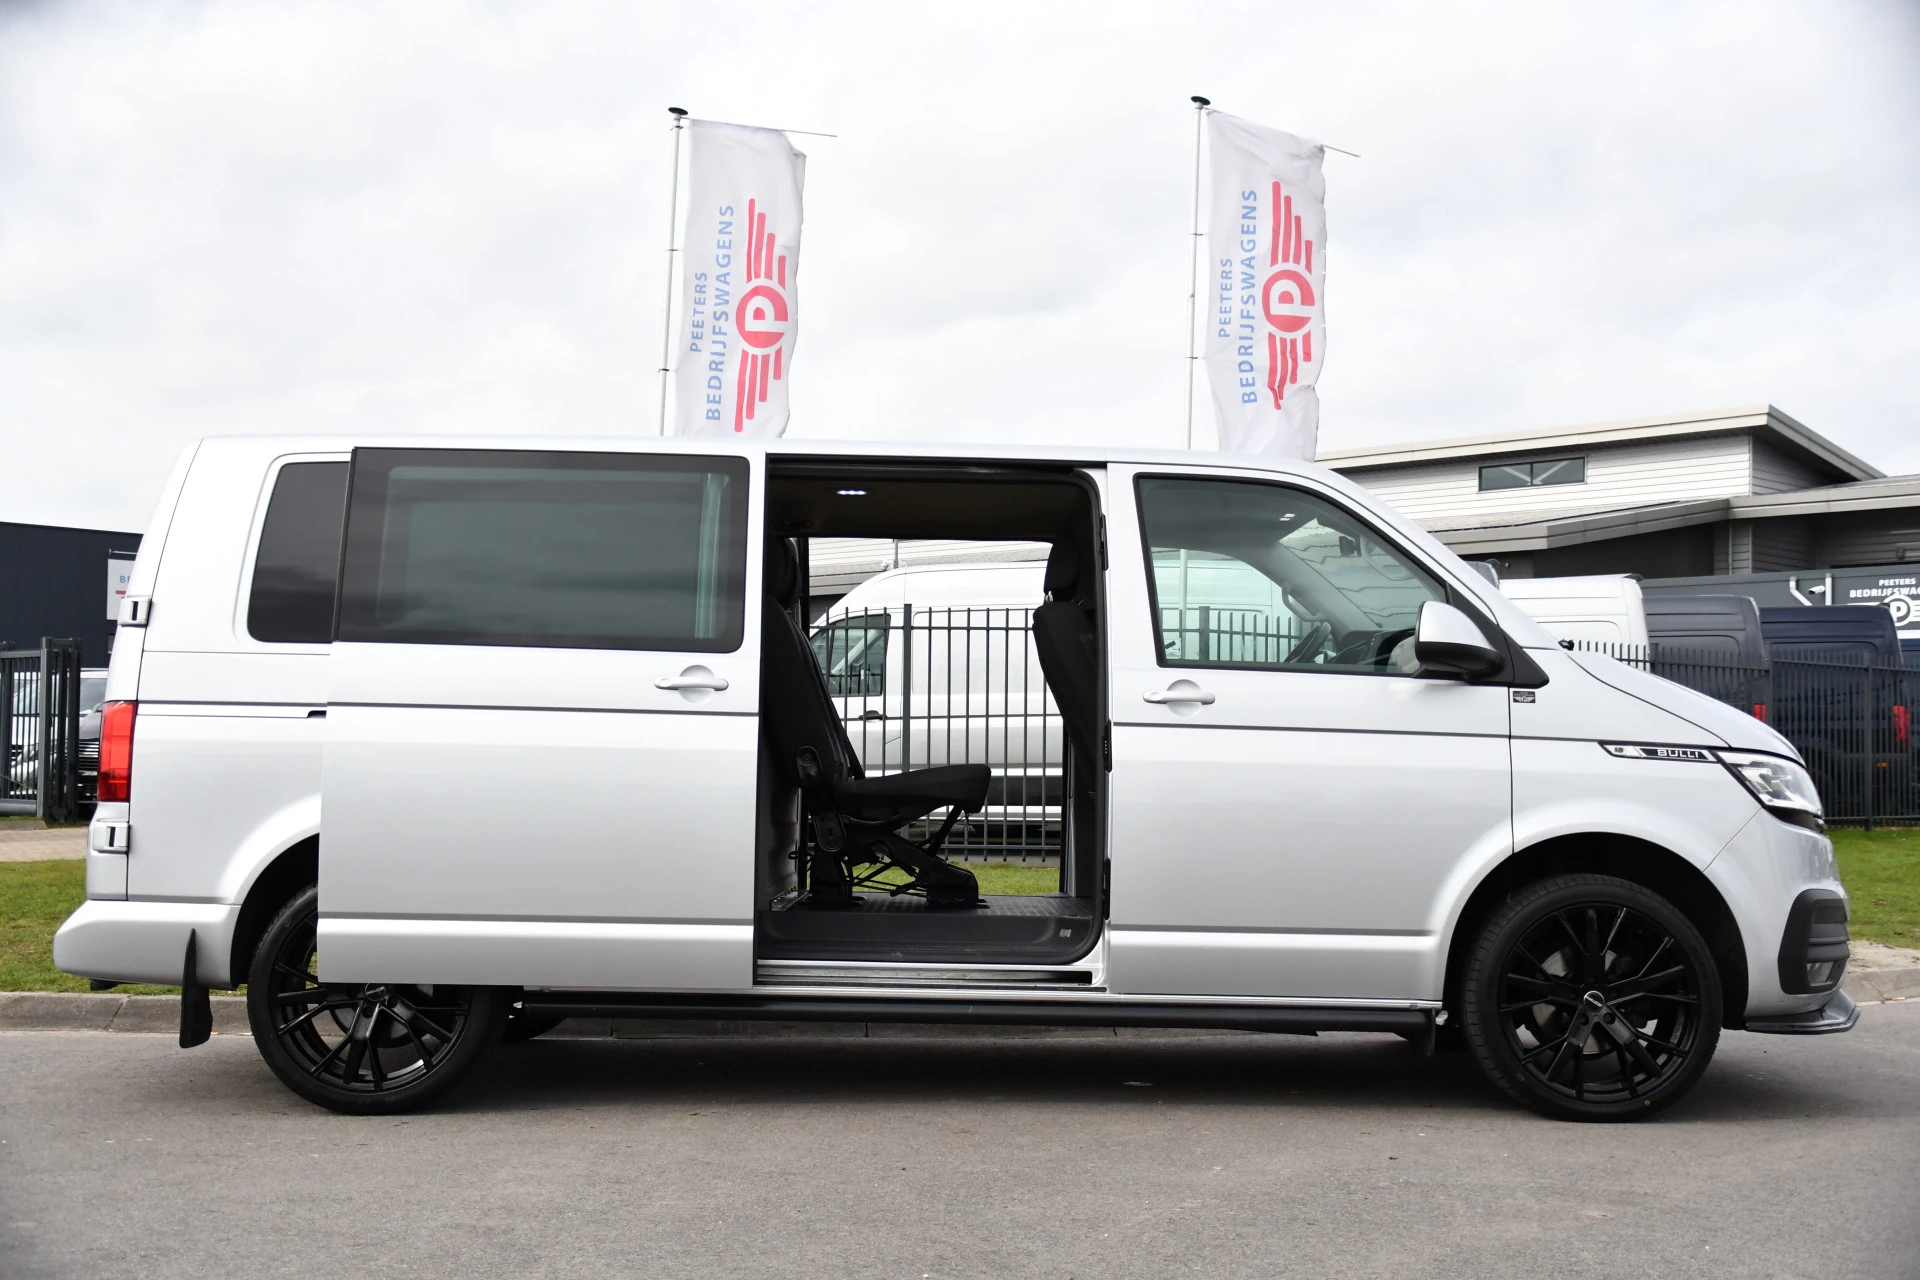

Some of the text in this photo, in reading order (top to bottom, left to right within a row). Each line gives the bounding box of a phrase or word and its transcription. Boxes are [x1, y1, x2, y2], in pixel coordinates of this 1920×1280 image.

[690, 271, 707, 352] PEETERS
[706, 205, 734, 421] BEDRIJFSWAGENS
[1218, 258, 1233, 339] PEETERS
[1238, 190, 1258, 405] BEDRIJFSWAGENS
[1879, 578, 1916, 586] PEETERS
[1657, 749, 1699, 758] BULLI
